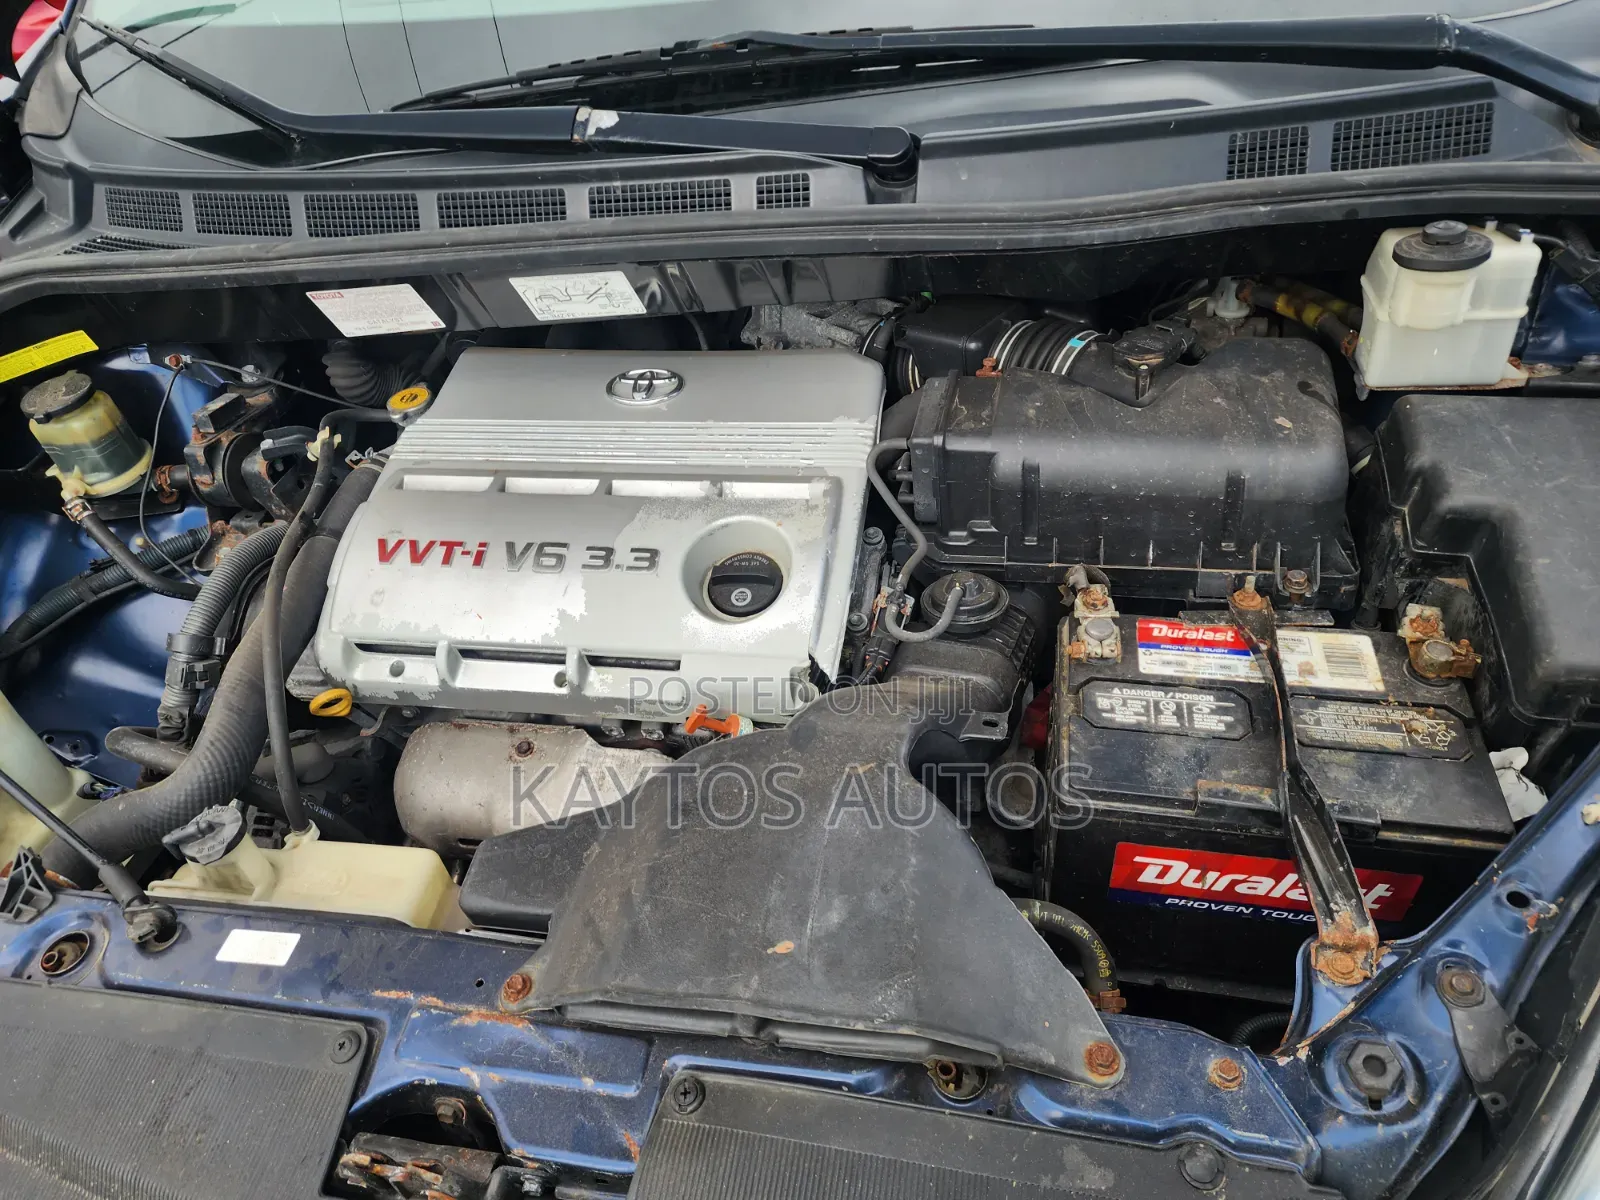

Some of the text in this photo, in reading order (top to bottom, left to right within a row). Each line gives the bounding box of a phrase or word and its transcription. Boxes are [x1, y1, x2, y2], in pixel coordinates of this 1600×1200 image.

[377, 538, 661, 574] VVT-i V6 3.3
[1149, 623, 1236, 642] Duralast
[1160, 644, 1229, 654] PROVEN TOUGH
[1122, 688, 1165, 698] DANGER
[1175, 692, 1215, 702] POISON
[1132, 855, 1394, 910] Duralat
[1165, 897, 1317, 923] PROVEN TOUG
